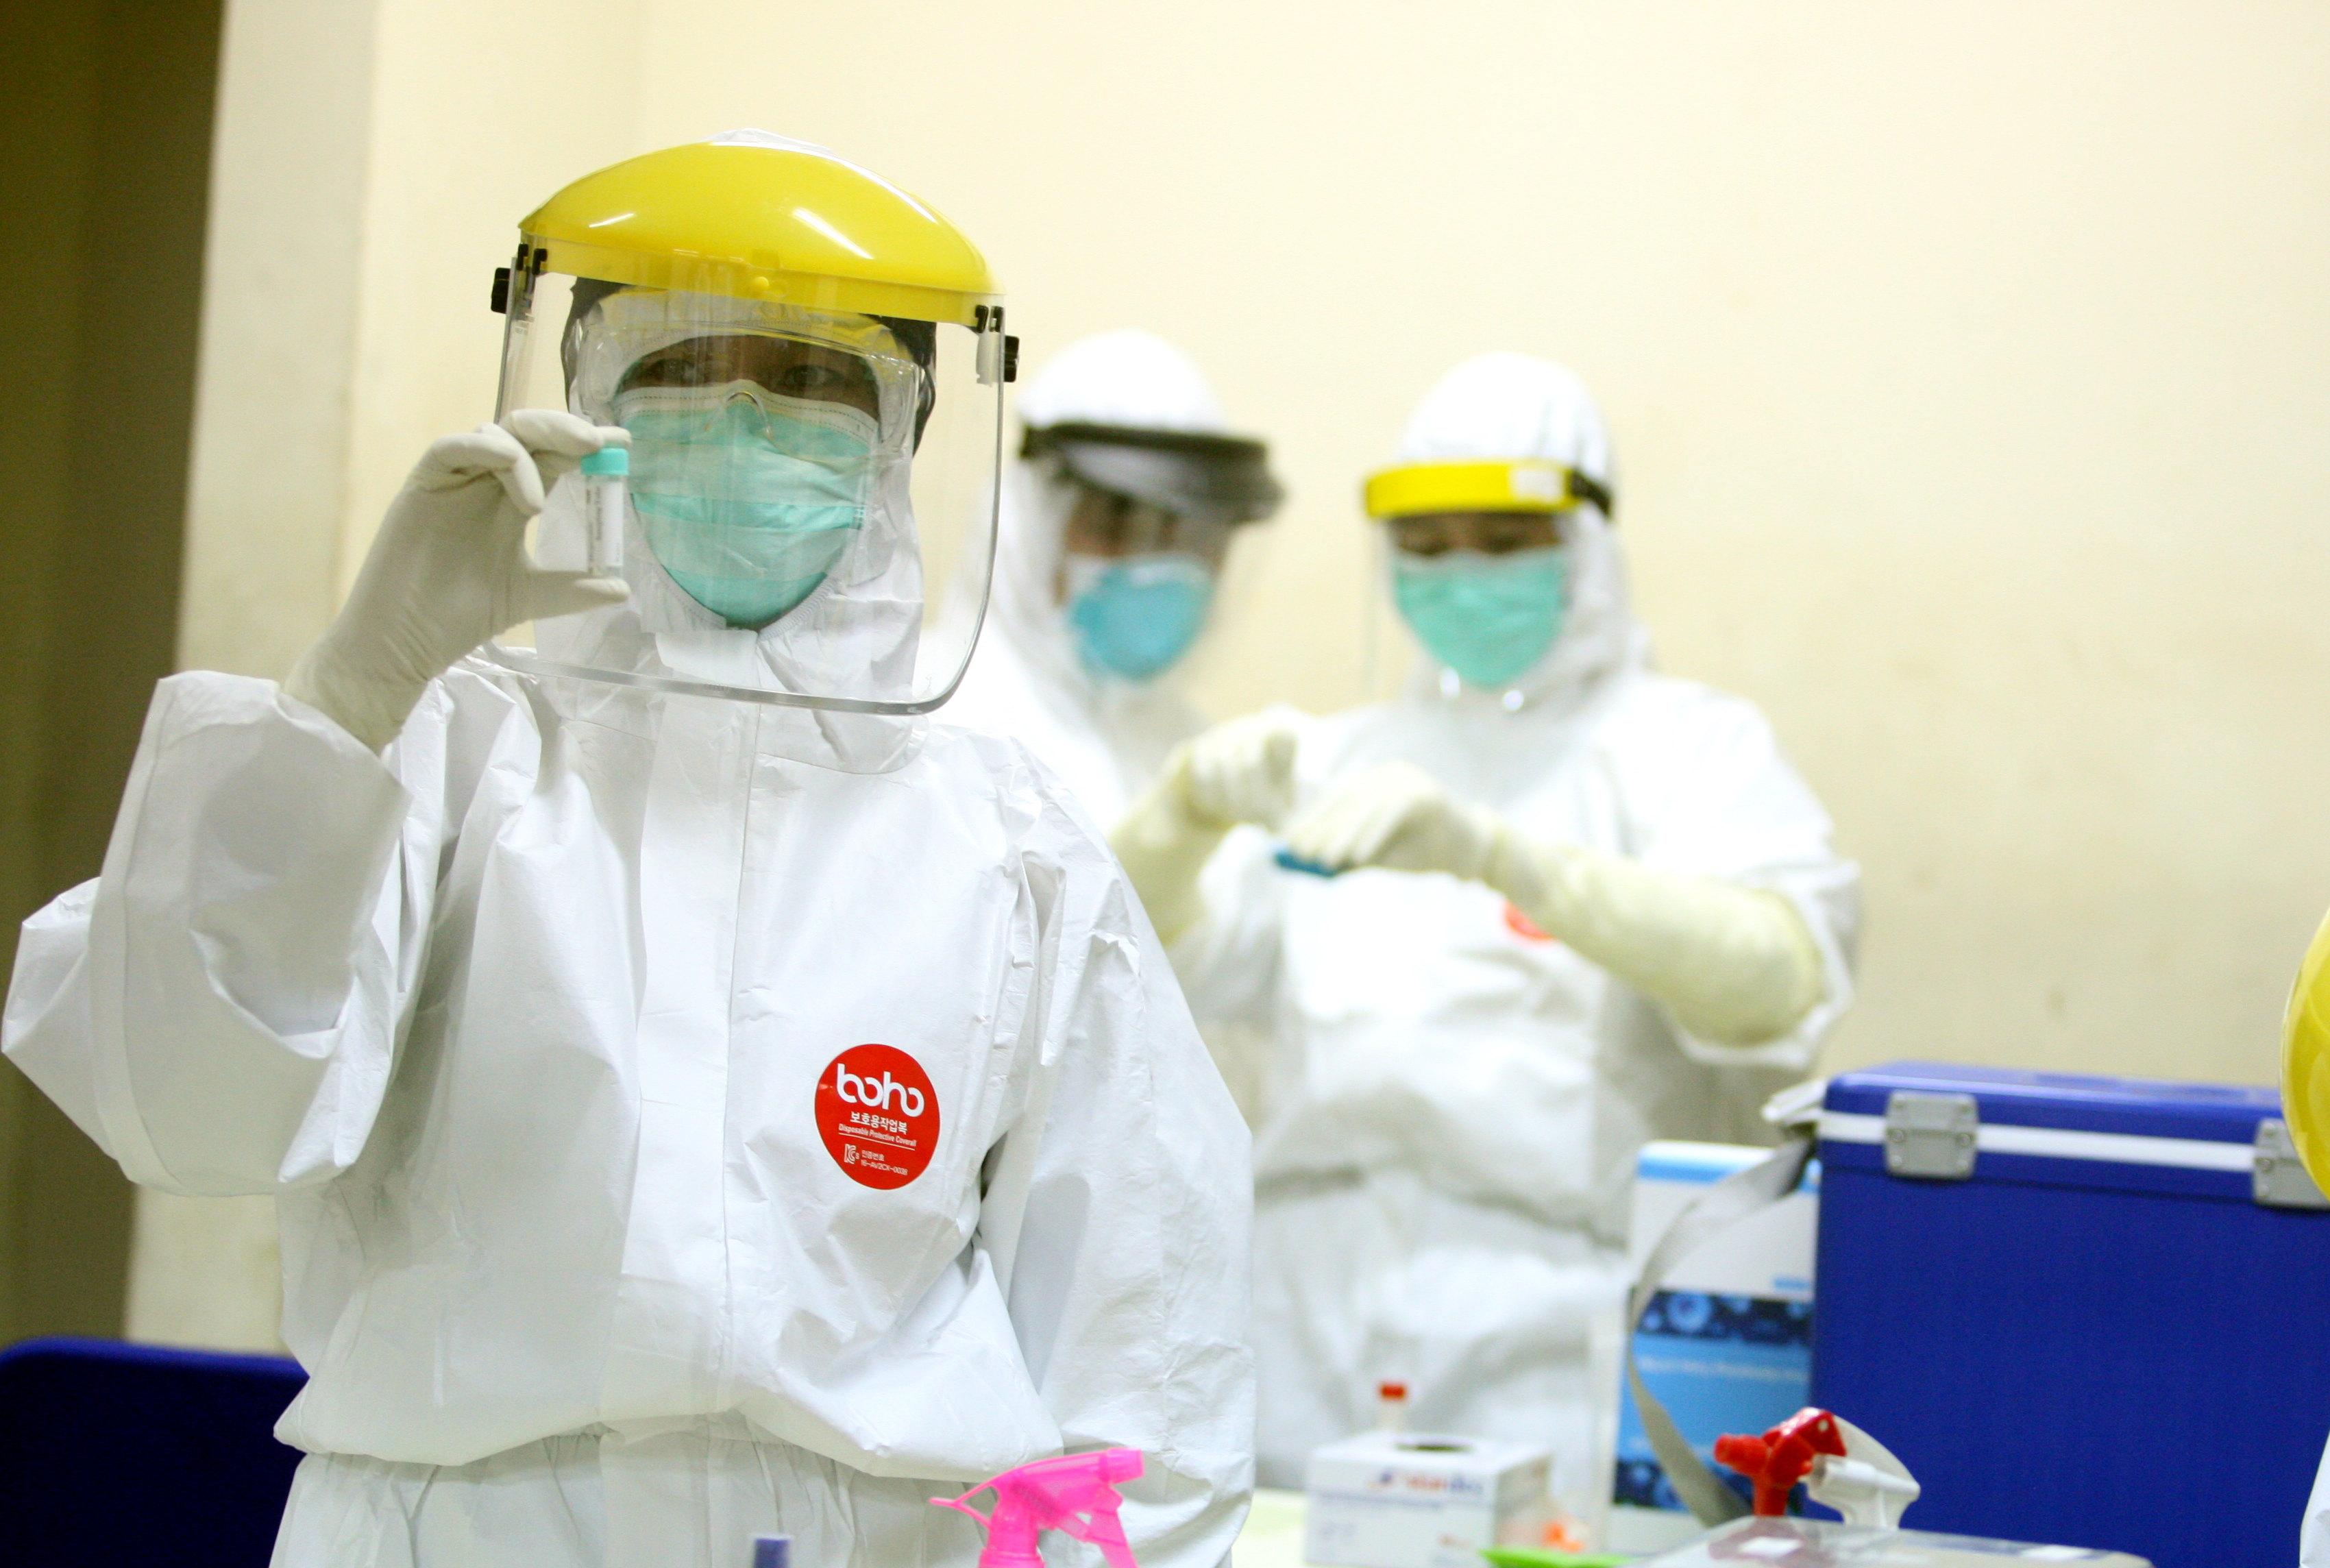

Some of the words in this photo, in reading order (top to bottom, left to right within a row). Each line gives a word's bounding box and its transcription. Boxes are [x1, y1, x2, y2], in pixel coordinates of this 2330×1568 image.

[836, 1063, 924, 1117] boho
[838, 1123, 869, 1136] Disposable
[869, 1129, 895, 1142] Protective
[895, 1136, 917, 1147] Coverall
[850, 1111, 907, 1135] 보호용작업복
